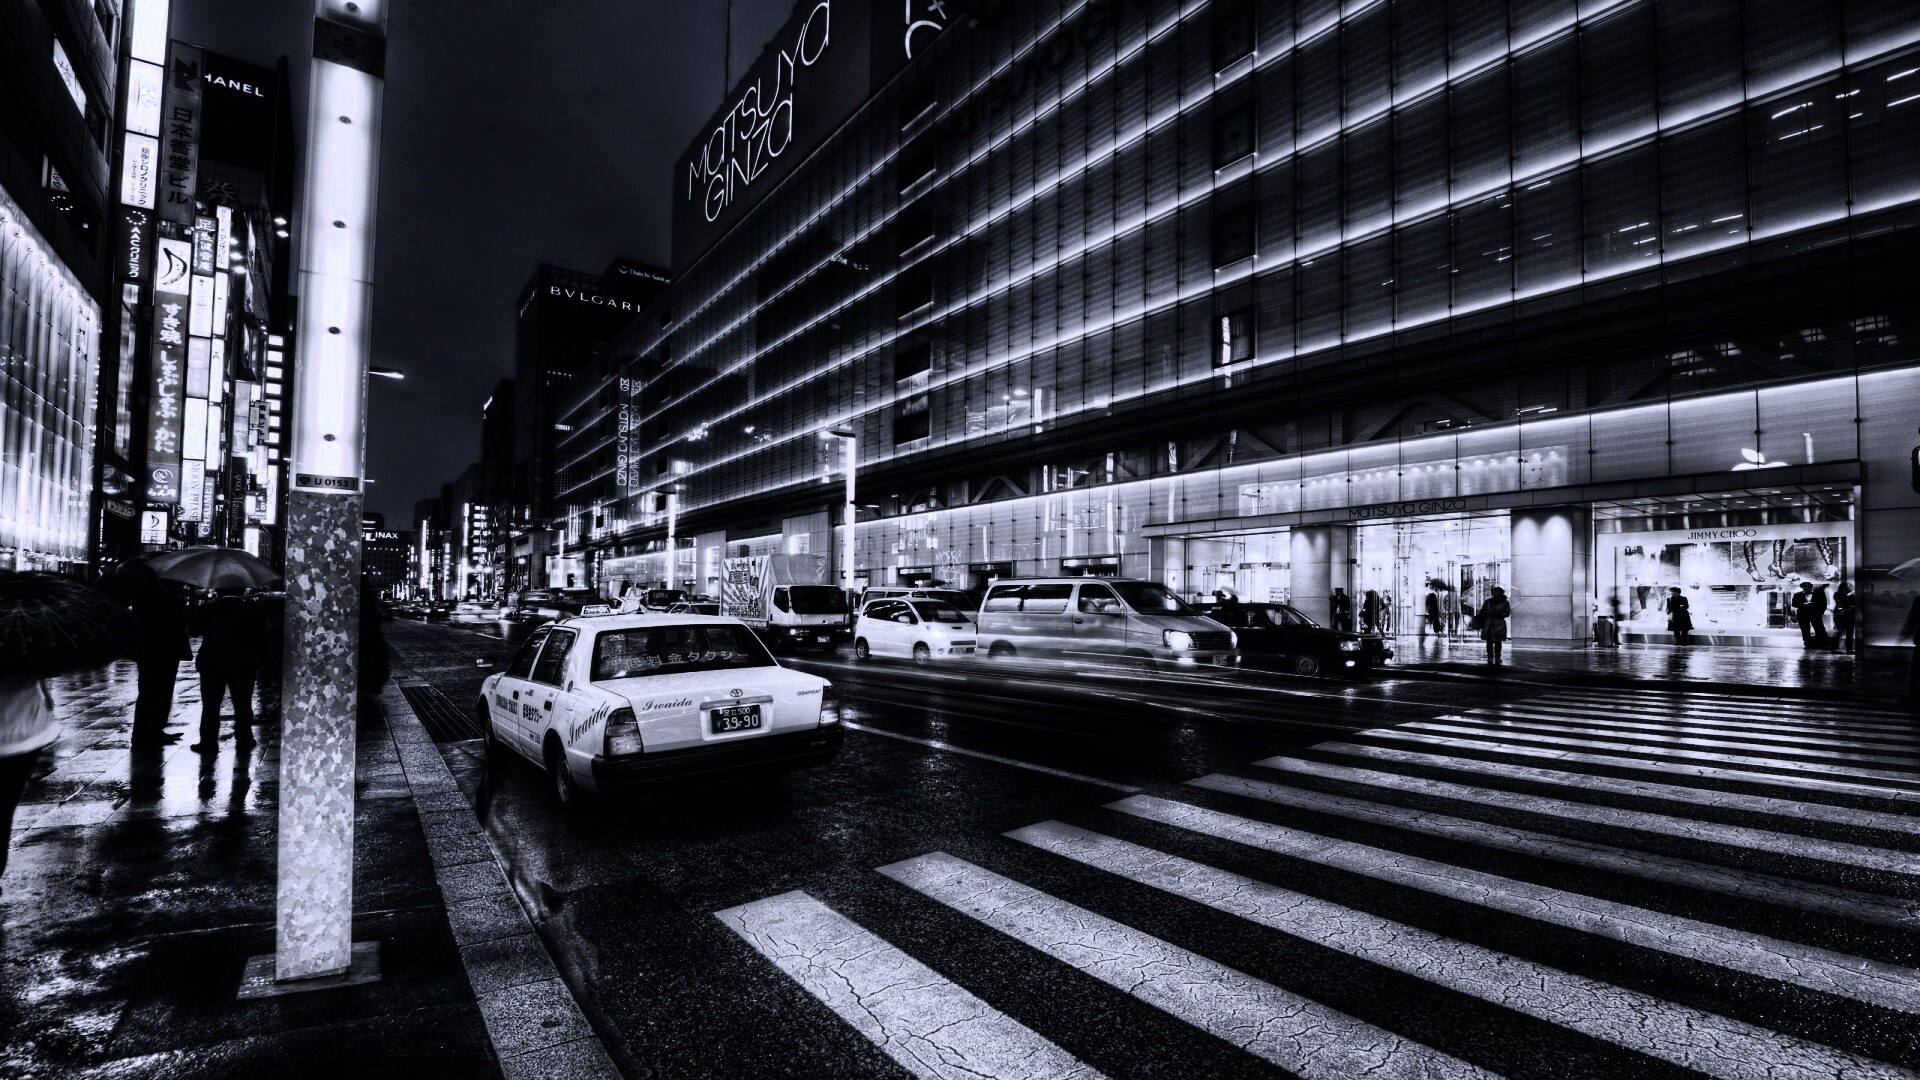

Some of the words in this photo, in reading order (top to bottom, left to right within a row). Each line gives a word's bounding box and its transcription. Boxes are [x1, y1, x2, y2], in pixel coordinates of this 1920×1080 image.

[168, 106, 193, 204] 日本香堂ビル
[550, 285, 642, 313] BVLGARI
[325, 478, 349, 488] 0153
[188, 493, 200, 521] PHASE
[200, 479, 215, 536] CHAUMET
[375, 531, 399, 539] INAX
[1688, 531, 1718, 540] JIMMY
[1720, 529, 1757, 538] CHOO
[625, 651, 749, 670] 低料金タクシー
[642, 697, 693, 711] Iwaida
[567, 700, 611, 747] Iwaida
[722, 714, 760, 731] 39-90
